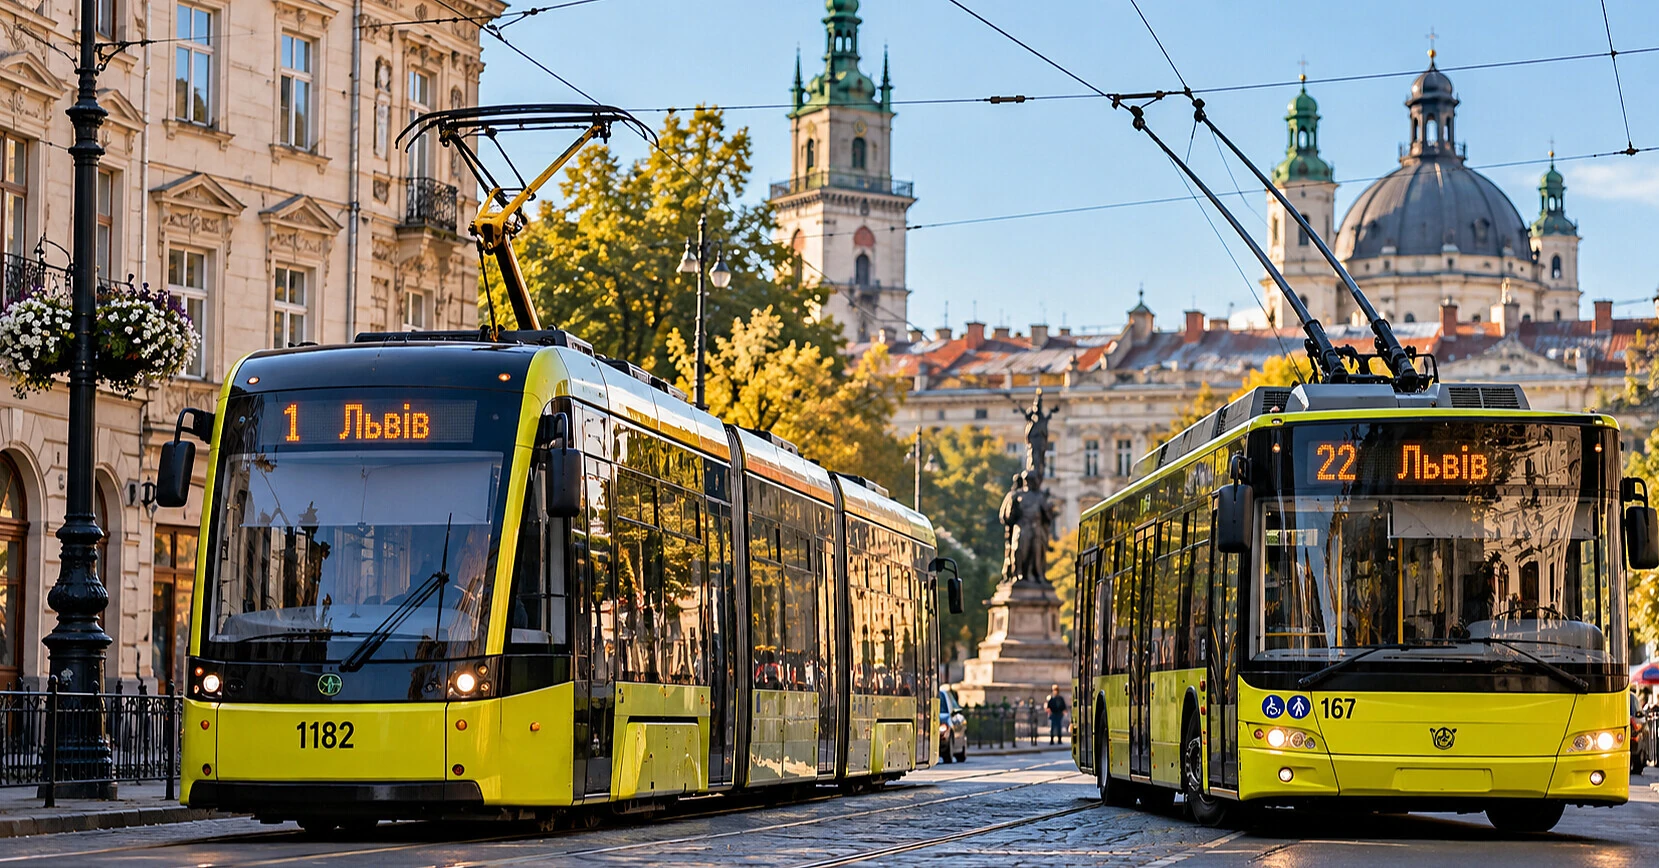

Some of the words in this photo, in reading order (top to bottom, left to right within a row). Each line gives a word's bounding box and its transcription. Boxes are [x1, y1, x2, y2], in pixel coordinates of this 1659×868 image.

[284, 403, 300, 442] 1
[339, 403, 430, 440] Львів
[1316, 443, 1357, 481] 22
[1397, 444, 1488, 480] Львів
[1320, 697, 1357, 719] 167
[296, 721, 355, 749] 1182
